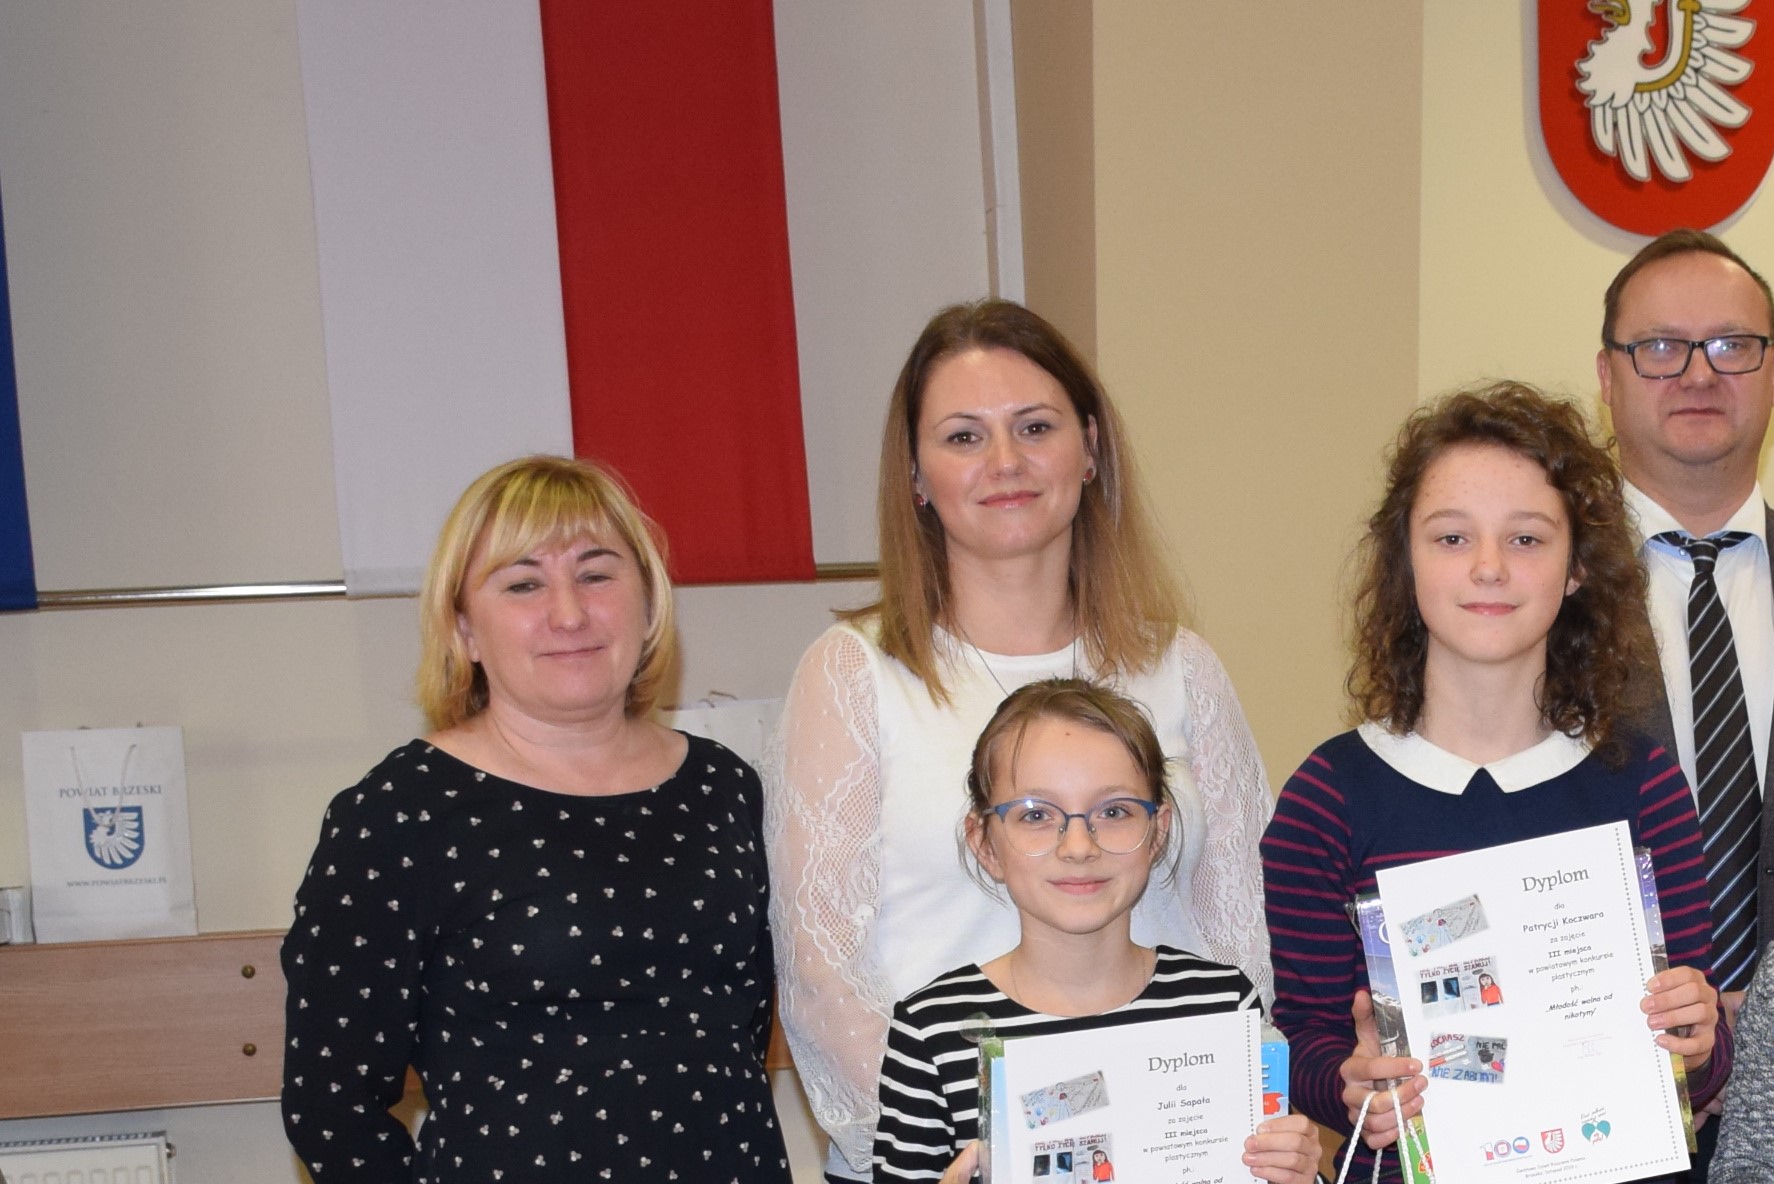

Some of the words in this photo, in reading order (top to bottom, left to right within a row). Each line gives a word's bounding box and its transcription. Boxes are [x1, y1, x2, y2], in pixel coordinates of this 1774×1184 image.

[1522, 868, 1590, 893] Dyplom
[1554, 902, 1565, 910] dla
[1523, 919, 1559, 933] Patrycji
[1562, 911, 1604, 925] Koczwara
[1548, 950, 1561, 958] III
[1564, 945, 1592, 955] miejsca
[1535, 959, 1578, 974] powiatowym
[1580, 952, 1614, 964] konkursie
[1551, 967, 1595, 983] plastycznym
[1581, 996, 1601, 1005] wolna
[1604, 992, 1614, 1001] od
[1148, 1052, 1215, 1074] Dyplom
[1176, 1084, 1187, 1092] dla
[1157, 1101, 1176, 1111] Julii
[1180, 1096, 1211, 1107] Sapała
[1164, 1131, 1178, 1139] III
[1180, 1128, 1208, 1137] miejsca
[1213, 1176, 1224, 1184] od
